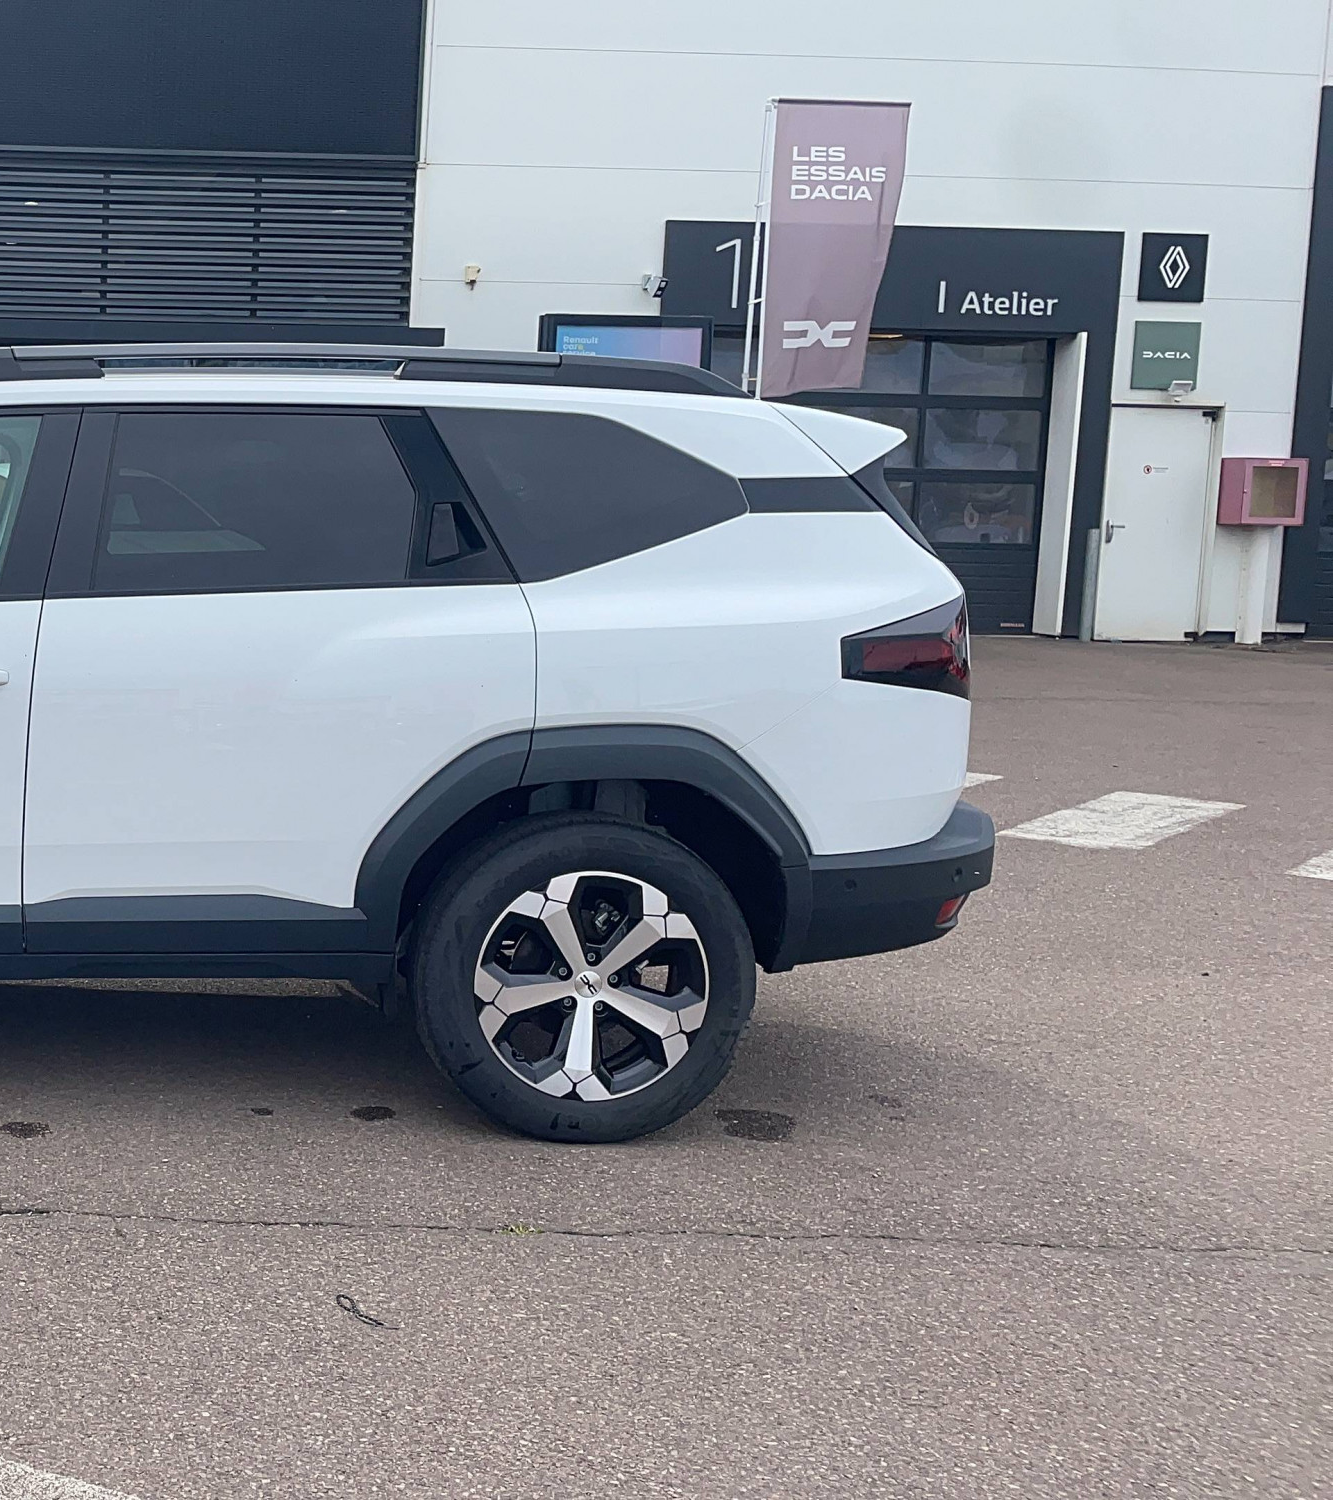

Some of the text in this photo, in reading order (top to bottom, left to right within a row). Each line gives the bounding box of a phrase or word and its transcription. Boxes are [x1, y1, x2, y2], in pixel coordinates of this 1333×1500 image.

[792, 145, 846, 162] LES
[791, 165, 887, 183] ESSAIS
[790, 184, 873, 201] DACIA
[959, 290, 1059, 316] Atelier
[563, 335, 599, 344] Renault
[1142, 350, 1191, 359] DACIA
